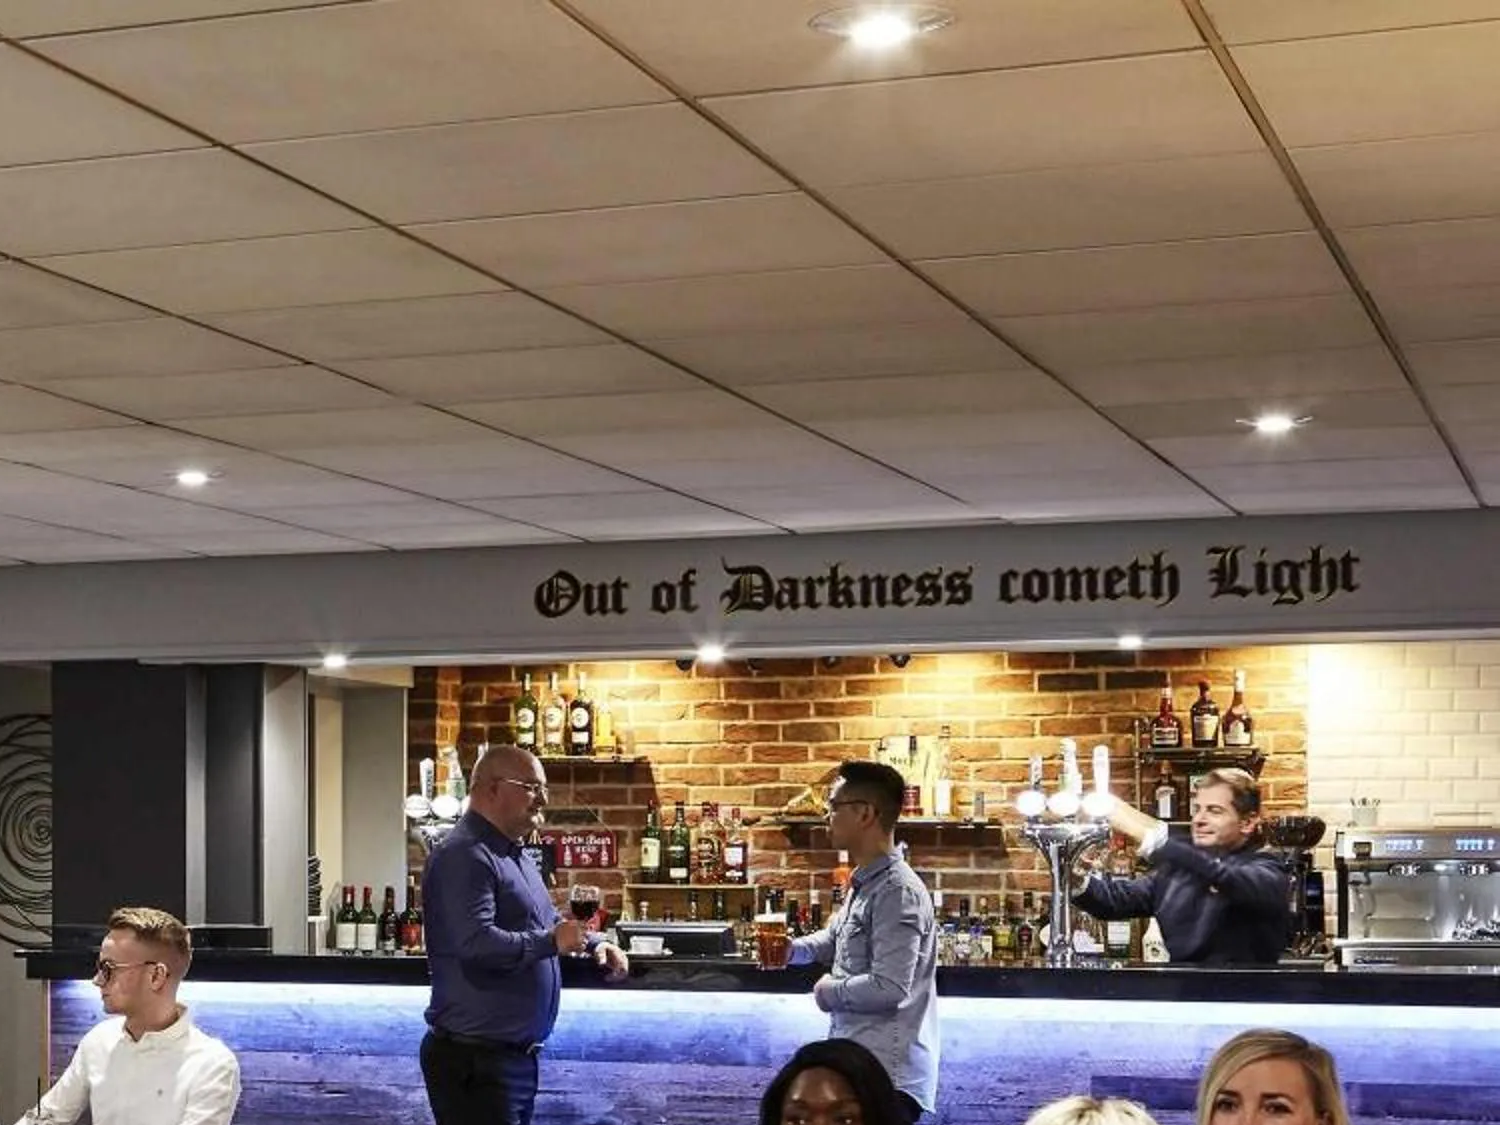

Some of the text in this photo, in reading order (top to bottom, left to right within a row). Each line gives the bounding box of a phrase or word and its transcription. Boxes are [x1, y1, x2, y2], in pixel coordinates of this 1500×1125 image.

[534, 543, 1361, 618] Out of Darkness cometh Light
